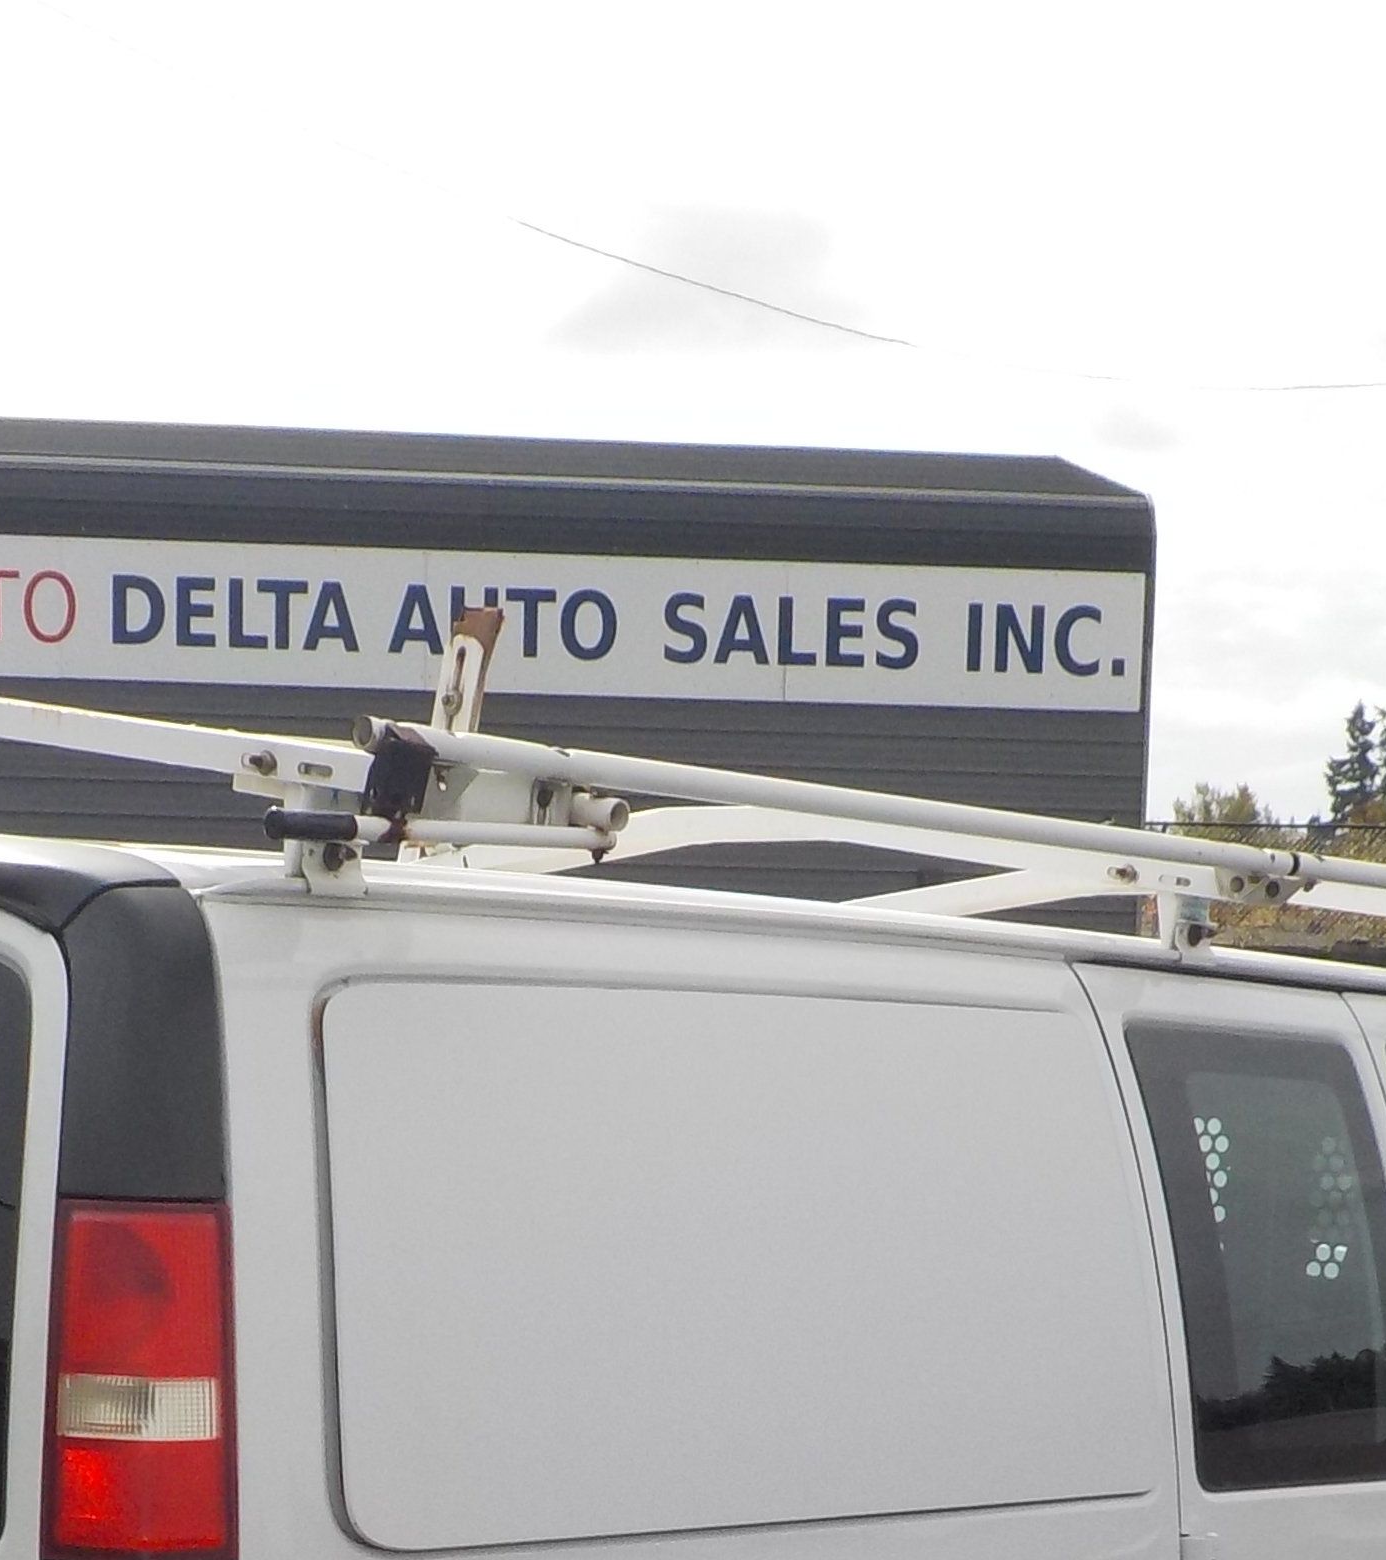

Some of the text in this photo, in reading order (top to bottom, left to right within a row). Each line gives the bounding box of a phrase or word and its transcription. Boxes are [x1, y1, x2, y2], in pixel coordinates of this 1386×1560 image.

[111, 572, 360, 654] DELTA
[663, 591, 920, 671] SALES
[966, 601, 1127, 678] INC.
